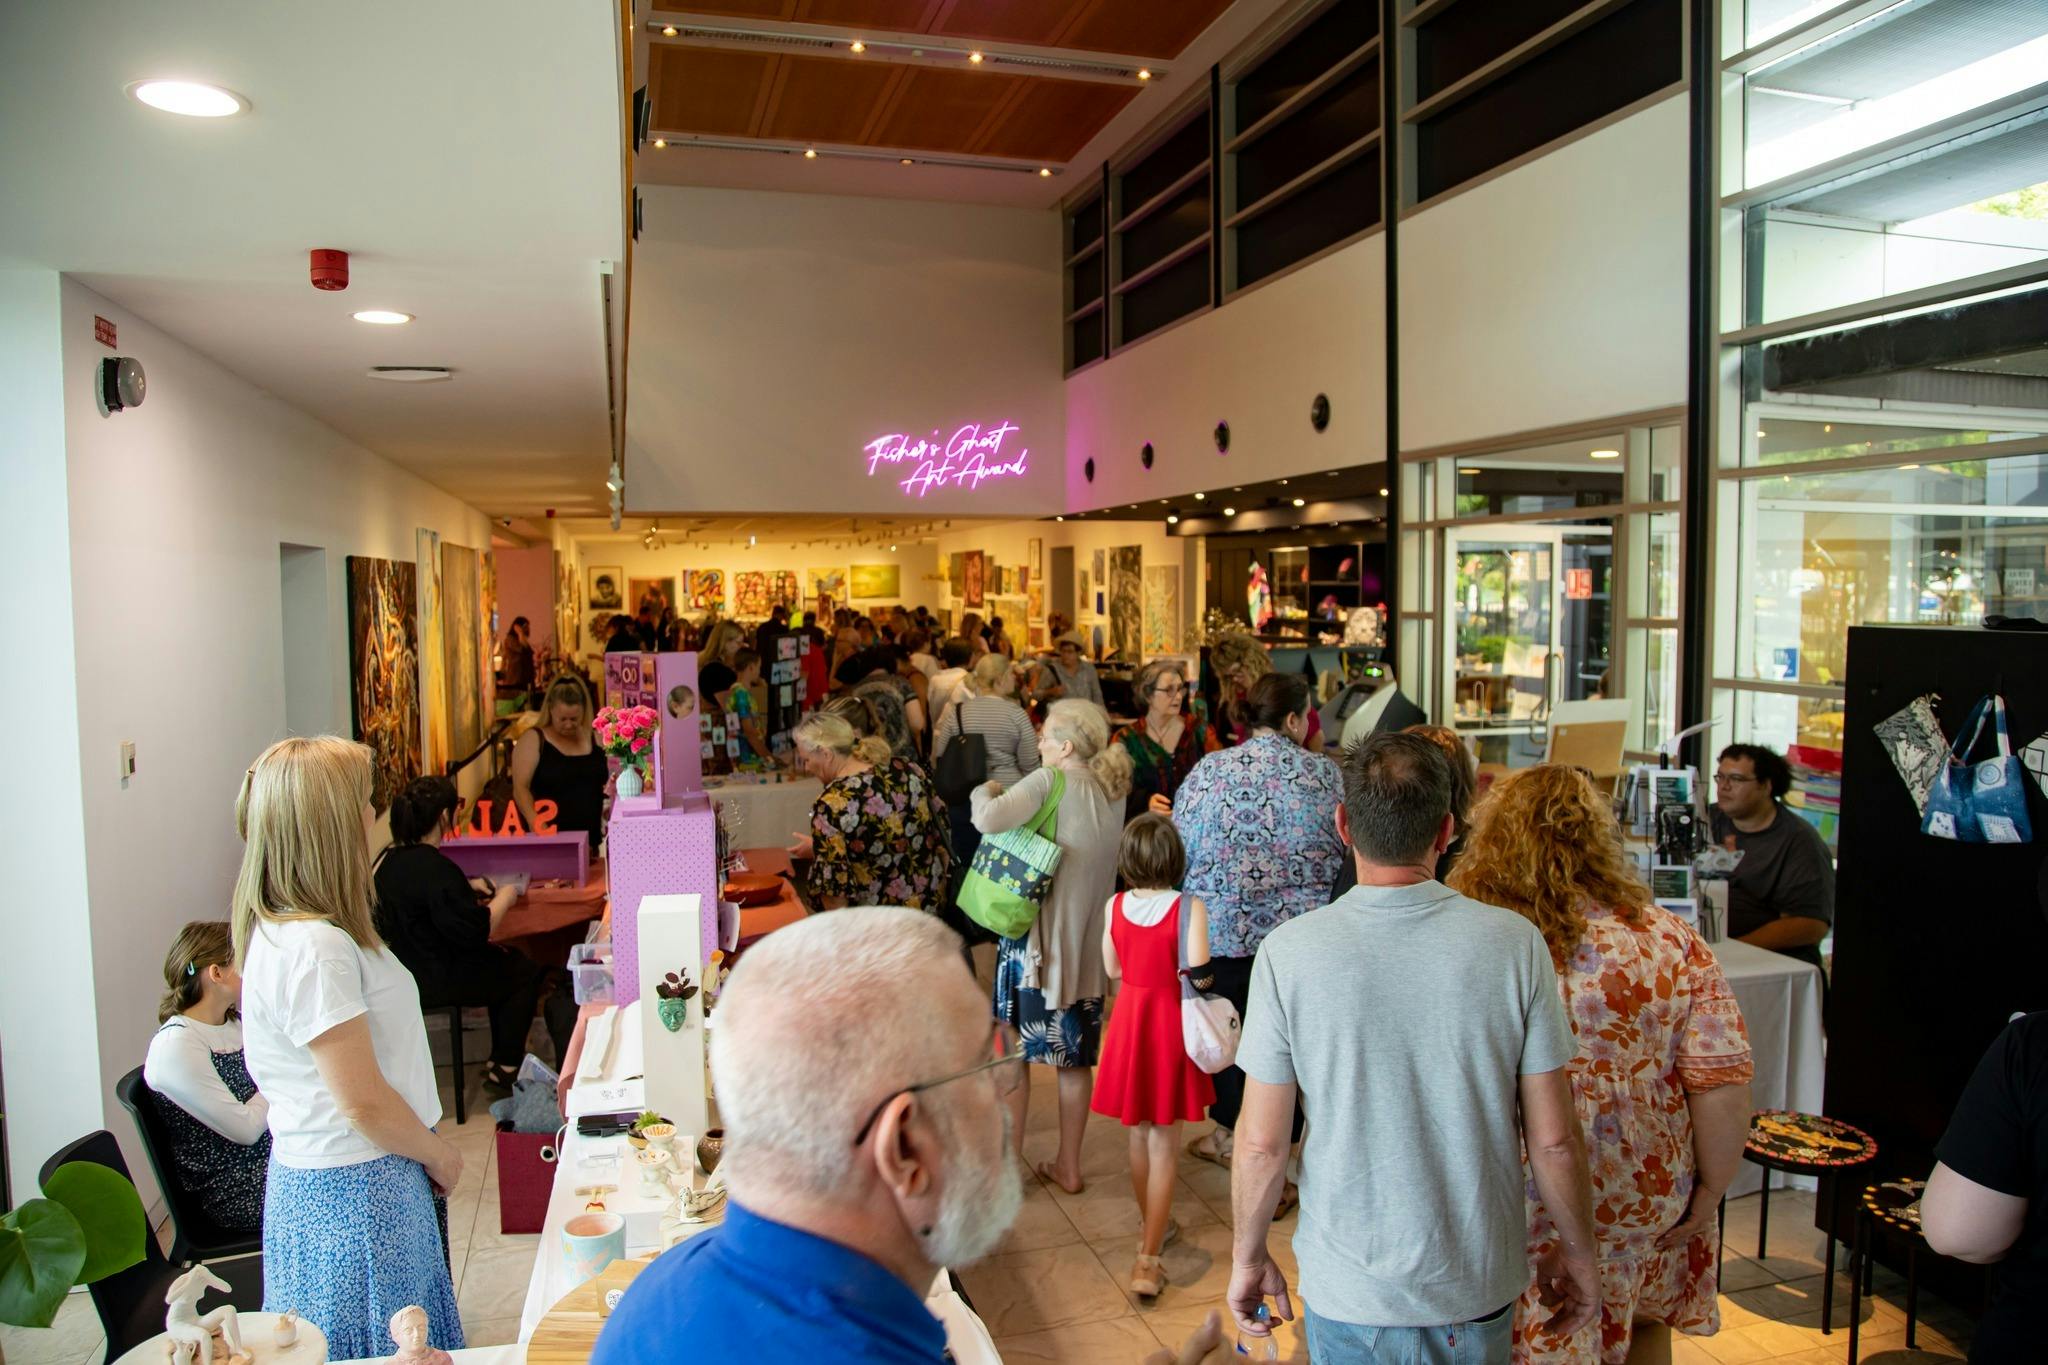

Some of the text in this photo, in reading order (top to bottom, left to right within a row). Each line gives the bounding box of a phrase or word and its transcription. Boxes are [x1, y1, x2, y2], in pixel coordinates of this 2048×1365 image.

[863, 421, 1020, 476] Fisher's Ghost
[900, 448, 1028, 497] Art Award
